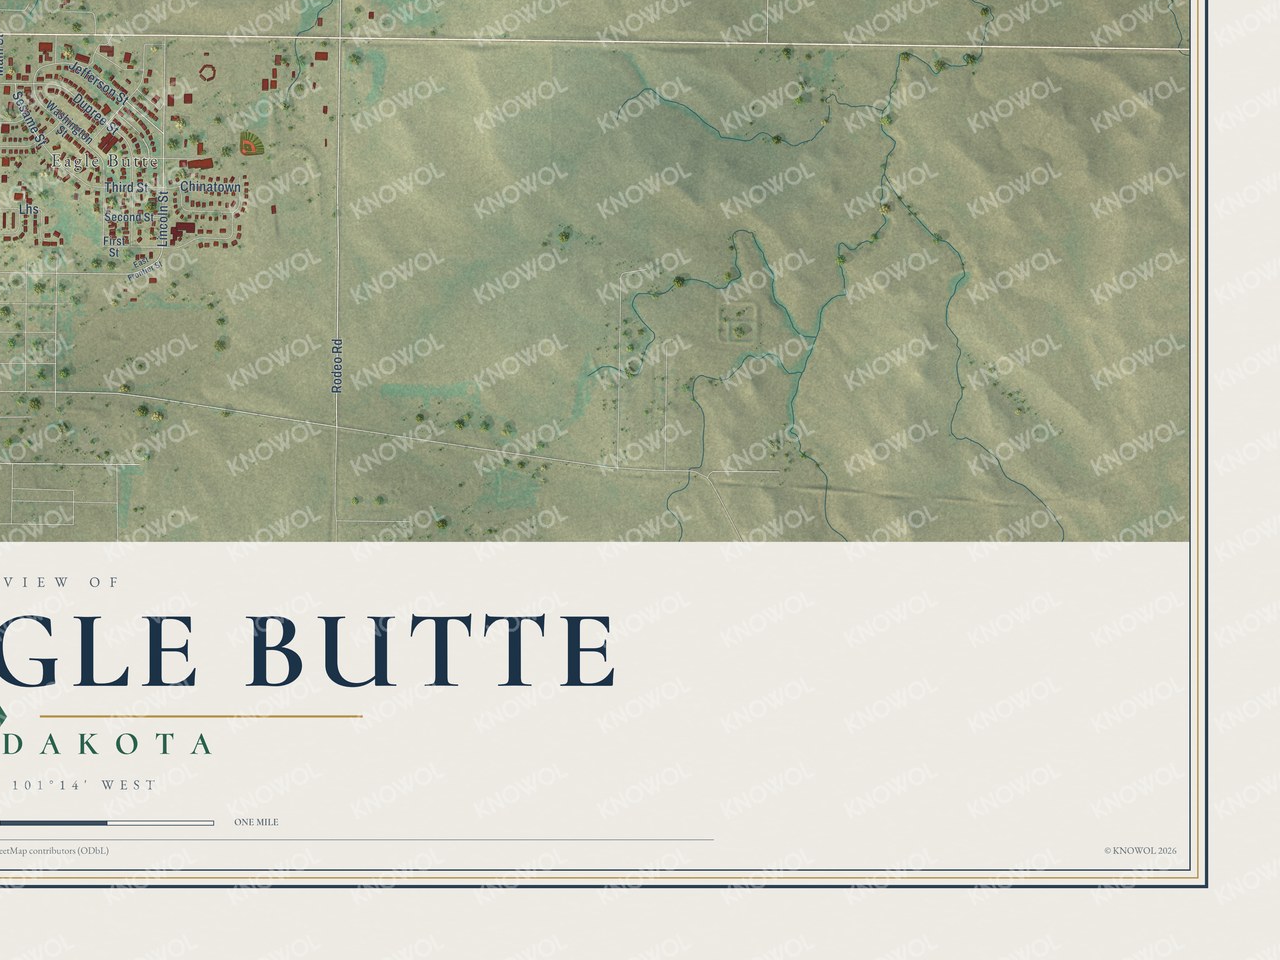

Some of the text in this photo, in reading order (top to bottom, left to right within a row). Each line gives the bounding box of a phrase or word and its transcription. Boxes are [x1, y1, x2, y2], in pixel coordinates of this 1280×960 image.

[68, 61, 129, 106] Jefferson St
[13, 91, 47, 147] Sesame St
[72, 93, 119, 136] Dupree St
[46, 100, 94, 145] Washington St
[51, 153, 159, 173] Eagle Butte
[104, 182, 148, 193] Third St
[180, 181, 241, 193] Chinatown
[19, 204, 39, 215] Lhs
[104, 212, 154, 222] Second St
[157, 191, 169, 247] Lincoln St
[103, 236, 125, 246] First
[109, 248, 119, 257] St
[133, 257, 149, 269] East
[154, 261, 163, 270] St
[331, 339, 343, 393] Rodeo Rd
[4, 576, 68, 588] VIEW
[90, 576, 119, 588] OF
[246, 614, 616, 688] BUTTE
[1, 732, 215, 756] DAKOTA
[102, 779, 156, 791] WEST
[234, 817, 279, 827] ONE MILE
[29, 846, 76, 855] contributors
[78, 846, 109, 857] (ODbL)
[1113, 846, 1157, 855] KNOWOL
[1158, 846, 1177, 855] 2026
